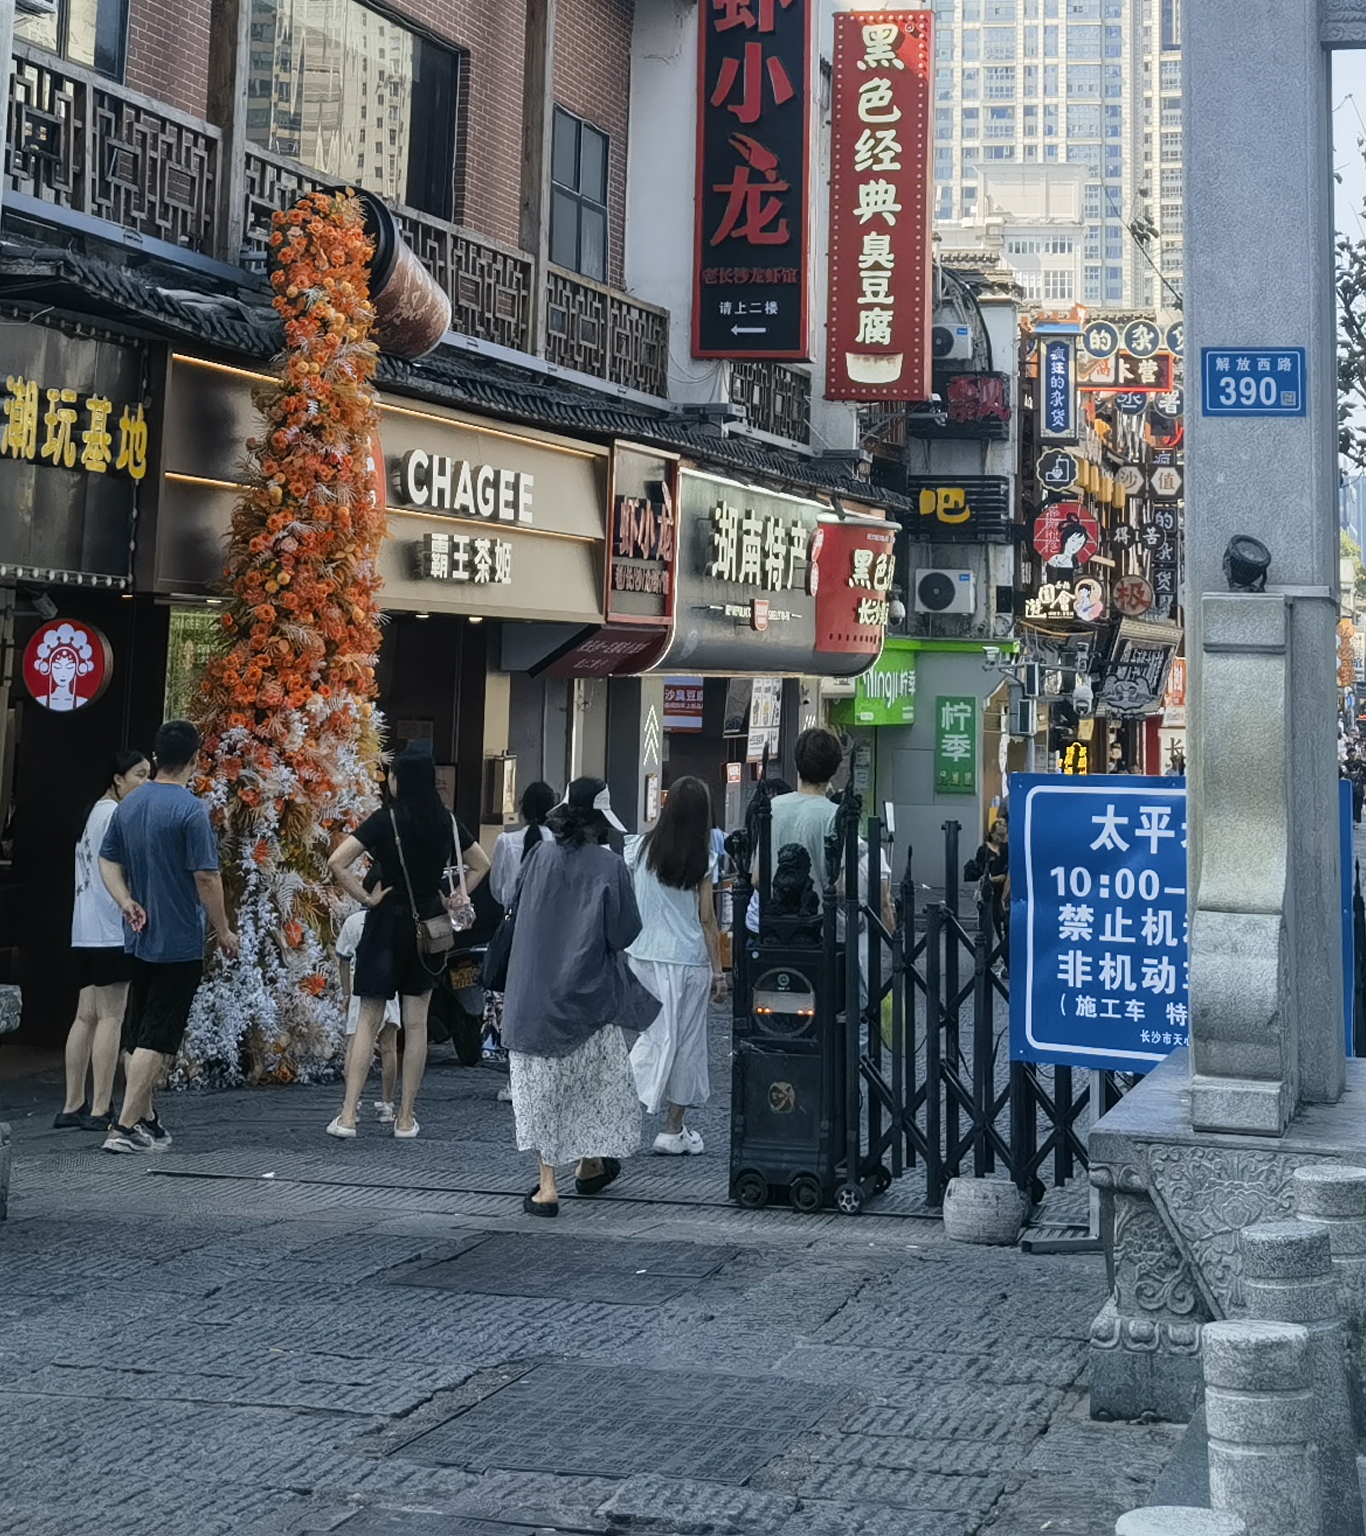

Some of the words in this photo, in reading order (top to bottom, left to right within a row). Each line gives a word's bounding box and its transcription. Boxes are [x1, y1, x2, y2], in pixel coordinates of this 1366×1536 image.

[852, 22, 905, 346] 黑色经典臭豆腐
[703, 267, 798, 285] 老长沙龙虾馆
[719, 301, 779, 315] 请上二楼
[1216, 357, 1293, 372] 解放西路
[1219, 376, 1278, 406] 390
[0, 375, 149, 480] 潮玩基地
[408, 449, 534, 524] CHAGEE
[919, 487, 971, 524] 吧
[1158, 471, 1176, 491] 值
[620, 486, 674, 562] 虾小龙
[712, 500, 807, 593] 湖南特产
[430, 532, 513, 585] 霸王茶姬
[941, 701, 972, 762] 柠季
[1089, 803, 1188, 855] 太平
[1057, 903, 1189, 948] 禁止机
[1057, 949, 1189, 995] 非机动
